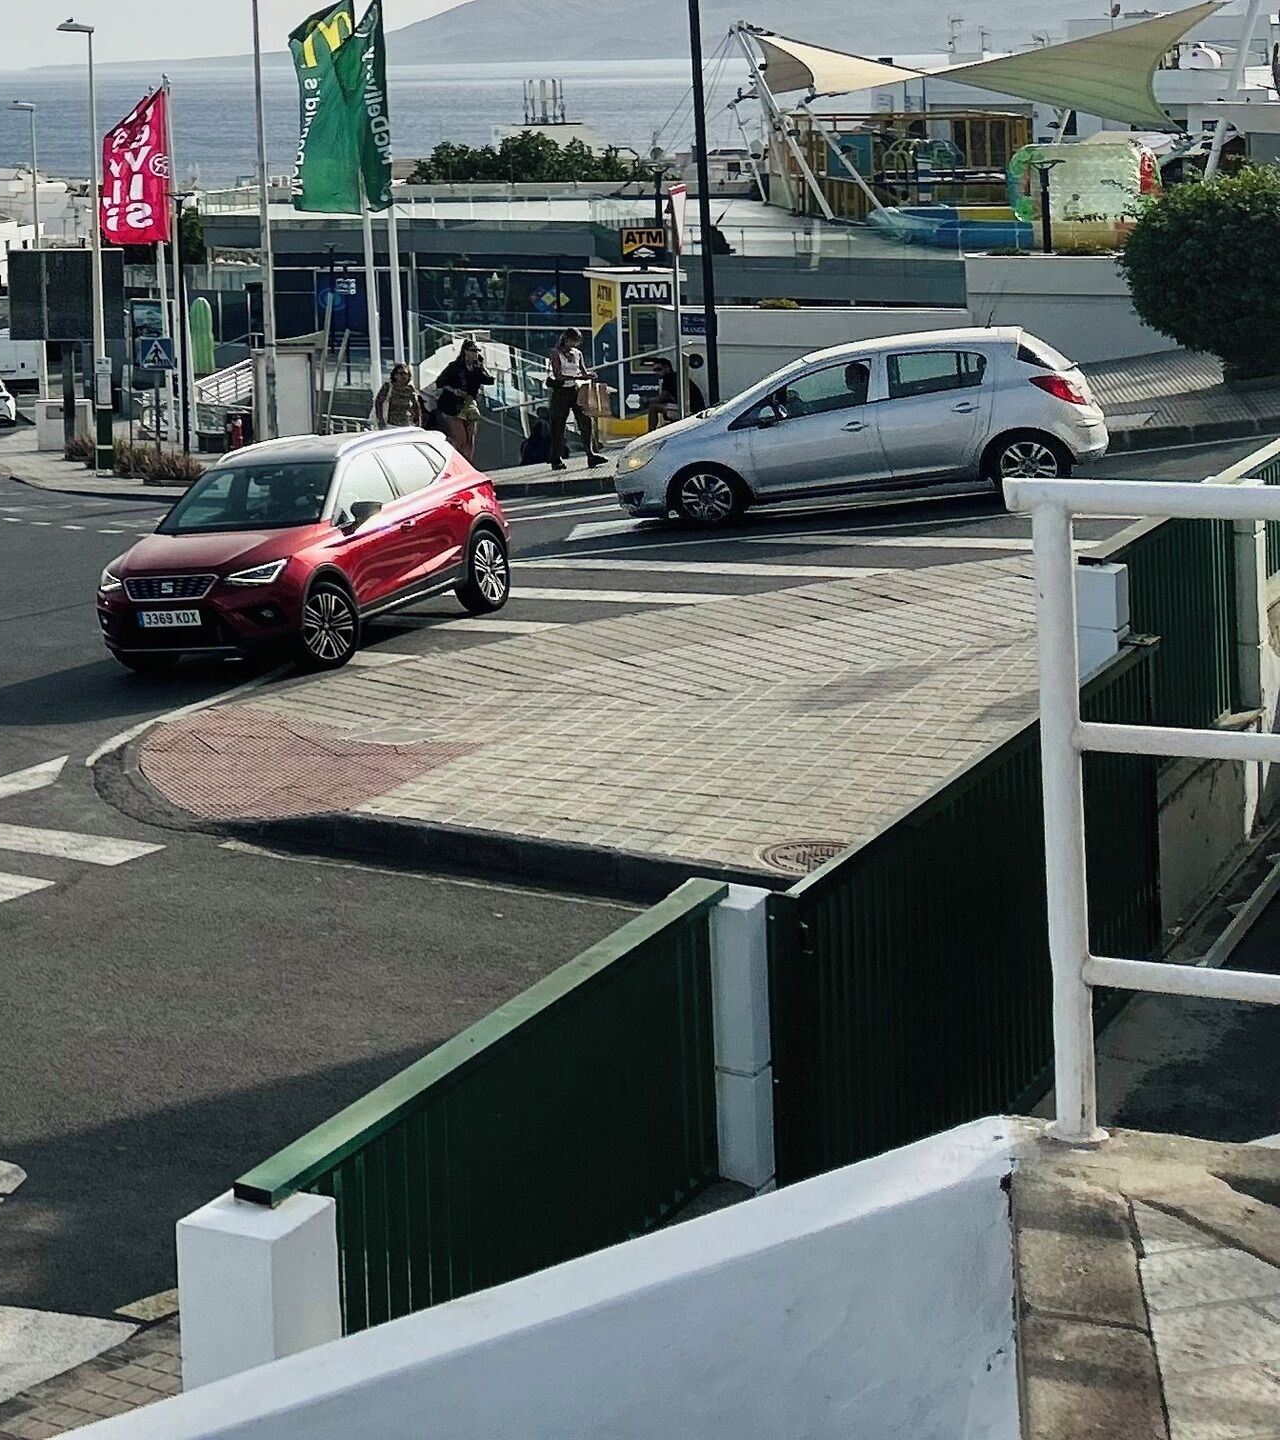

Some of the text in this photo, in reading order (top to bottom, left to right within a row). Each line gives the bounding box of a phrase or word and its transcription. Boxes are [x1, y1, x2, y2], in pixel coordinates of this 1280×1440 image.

[624, 231, 663, 245] ATM
[597, 285, 612, 302] ATM
[624, 284, 668, 299] ATM
[145, 612, 199, 625] 3369 KDX
